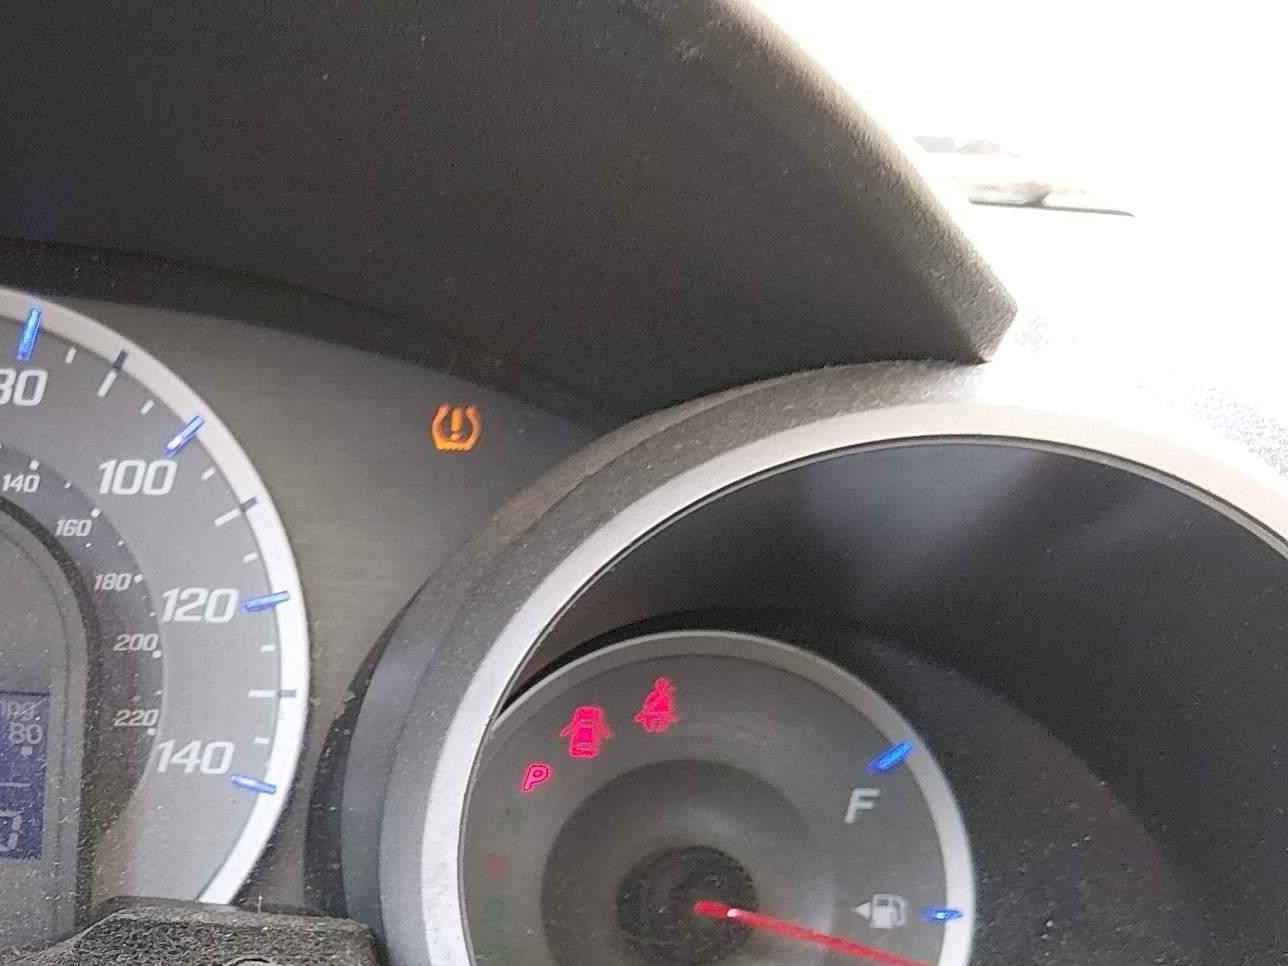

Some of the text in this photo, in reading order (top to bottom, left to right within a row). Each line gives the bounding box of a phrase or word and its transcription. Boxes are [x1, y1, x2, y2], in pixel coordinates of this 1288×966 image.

[2, 473, 40, 493] 140
[99, 459, 178, 496] 100
[55, 519, 93, 537] 160
[94, 572, 132, 592] 180
[162, 587, 239, 623] 120
[113, 633, 159, 652] 200
[114, 709, 159, 727] 220
[9, 723, 43, 745] 80
[157, 738, 234, 775] 140
[521, 763, 550, 792] P
[844, 788, 880, 824] F
